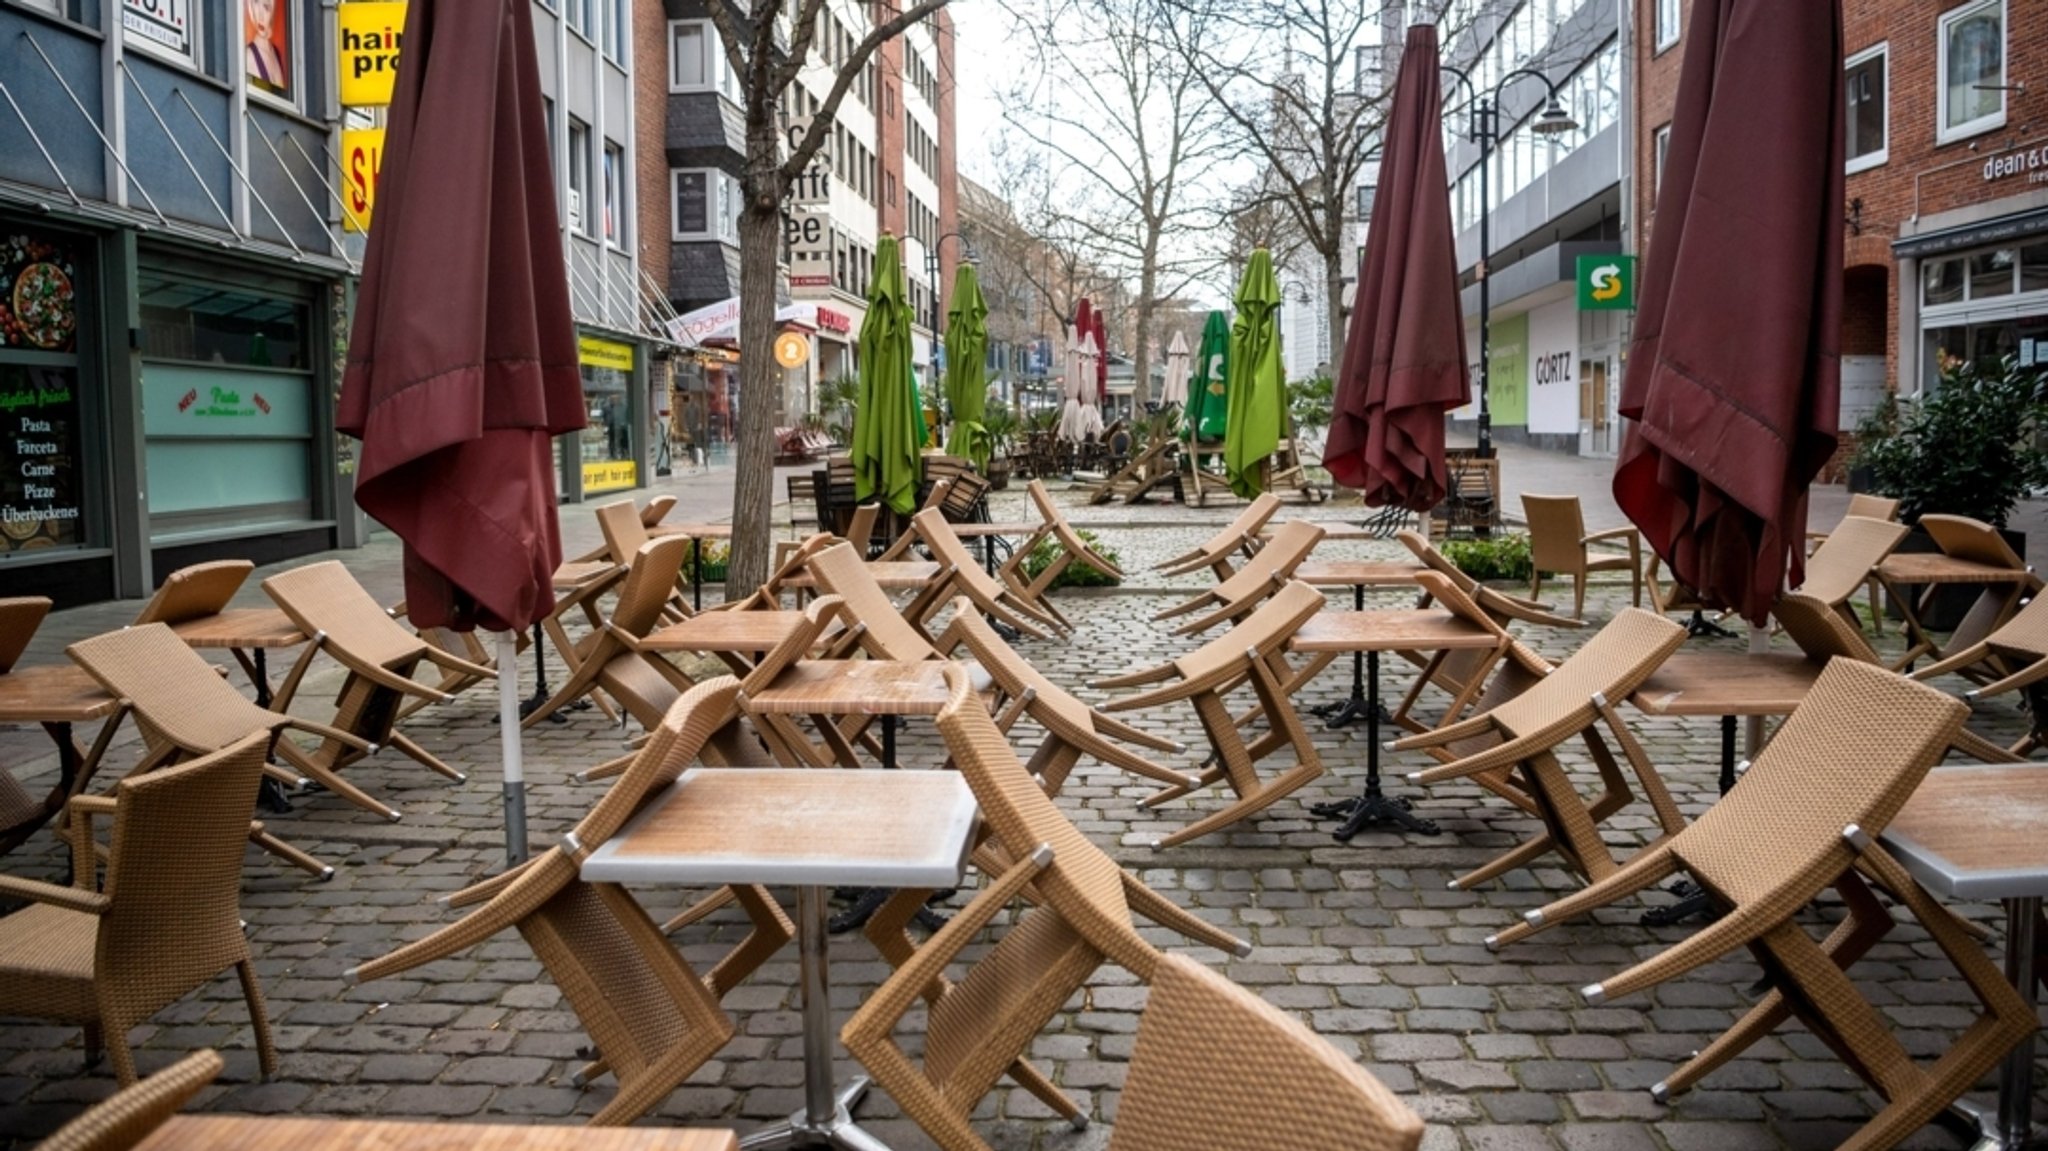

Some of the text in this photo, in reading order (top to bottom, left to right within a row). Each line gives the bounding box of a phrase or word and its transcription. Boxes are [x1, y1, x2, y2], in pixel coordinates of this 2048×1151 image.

[1984, 155, 2025, 179] dean
[2028, 150, 2040, 168] &
[178, 388, 197, 412] NEU
[253, 392, 271, 415] NEU
[21, 416, 51, 432] Pasta
[21, 461, 56, 476] Carne
[24, 483, 56, 499] Pizze
[2, 504, 79, 522] Überbackenes
